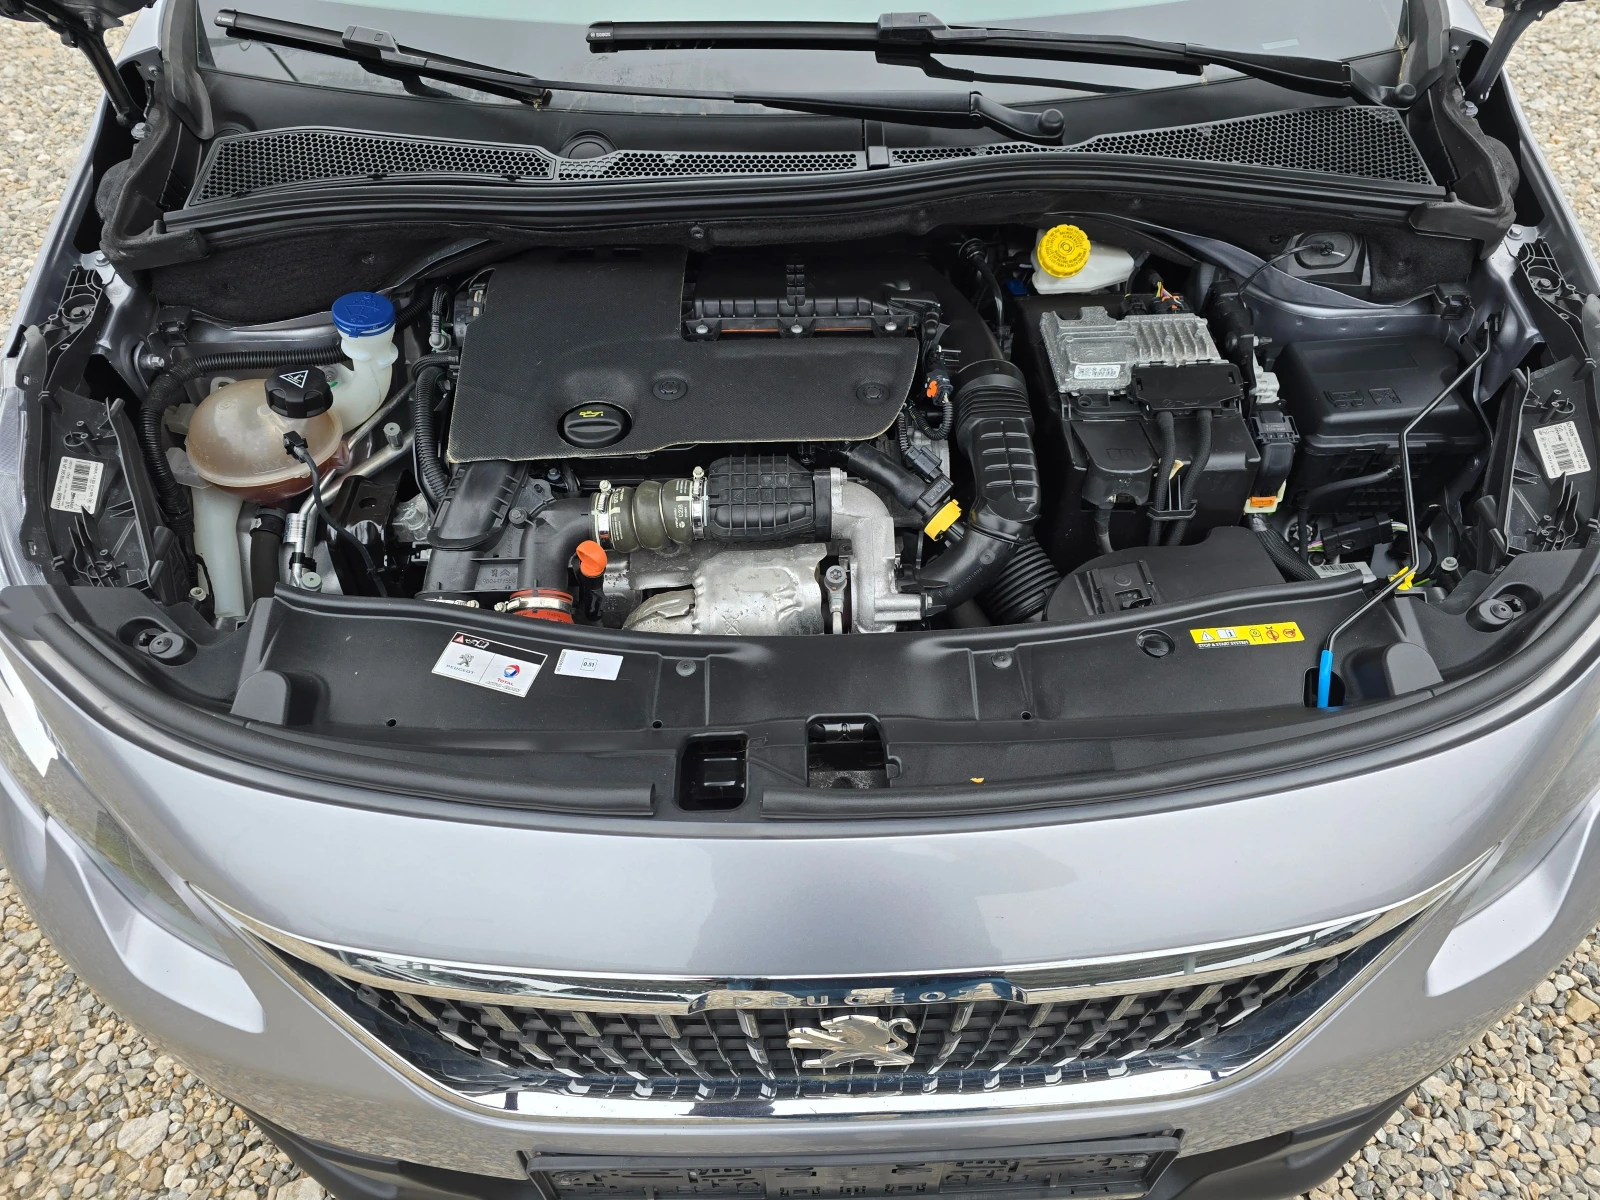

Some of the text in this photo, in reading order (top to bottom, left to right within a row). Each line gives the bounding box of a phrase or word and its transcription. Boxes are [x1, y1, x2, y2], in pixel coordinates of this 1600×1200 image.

[446, 664, 475, 675] PEUGEOT
[497, 677, 515, 686] TOTAL
[732, 988, 983, 1006] PEUGEOT
